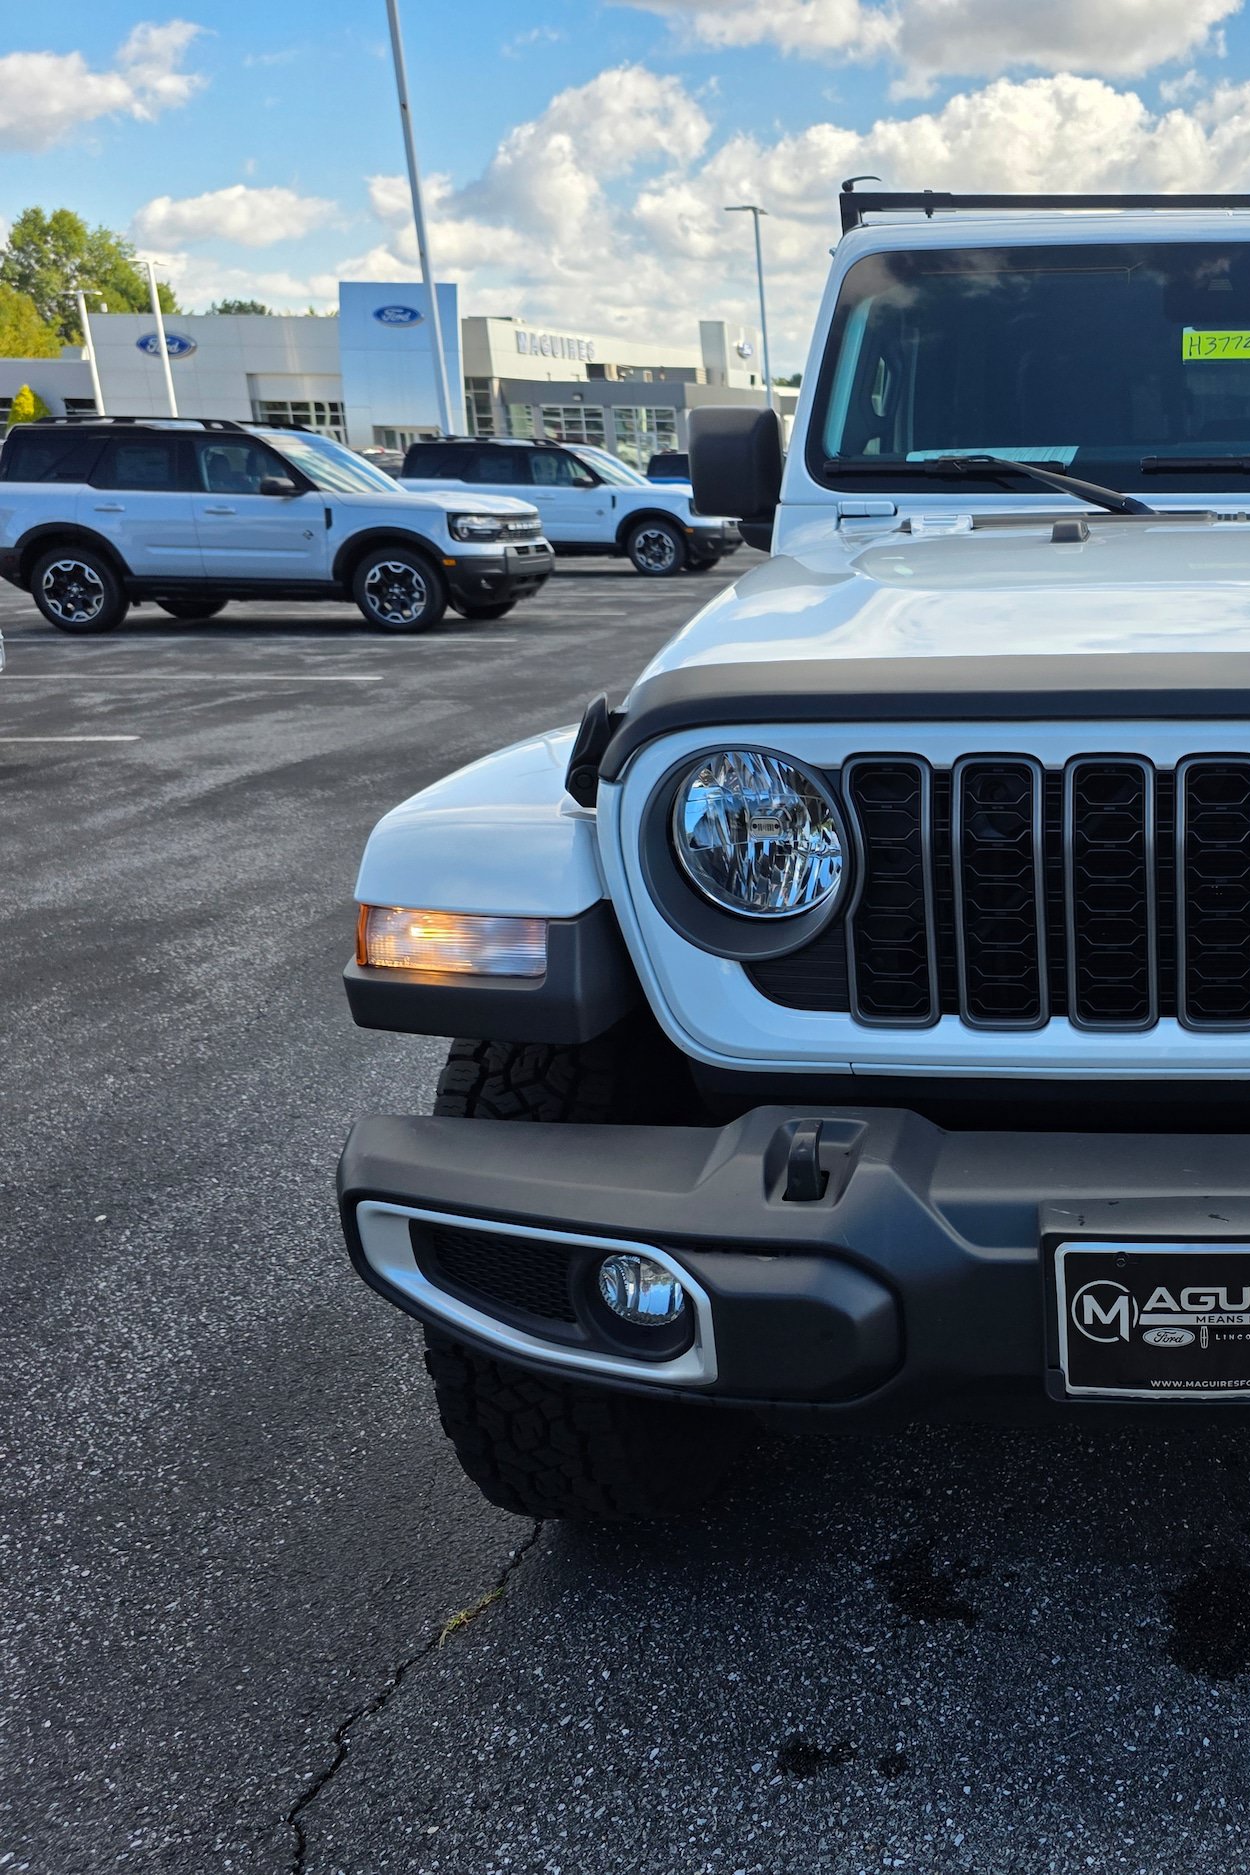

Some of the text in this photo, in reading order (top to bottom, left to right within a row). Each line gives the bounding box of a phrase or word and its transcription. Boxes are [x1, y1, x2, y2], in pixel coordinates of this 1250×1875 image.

[381, 309, 411, 321] Ford
[1195, 1314, 1244, 1324] MEANS
[1153, 1331, 1185, 1343] Ford
